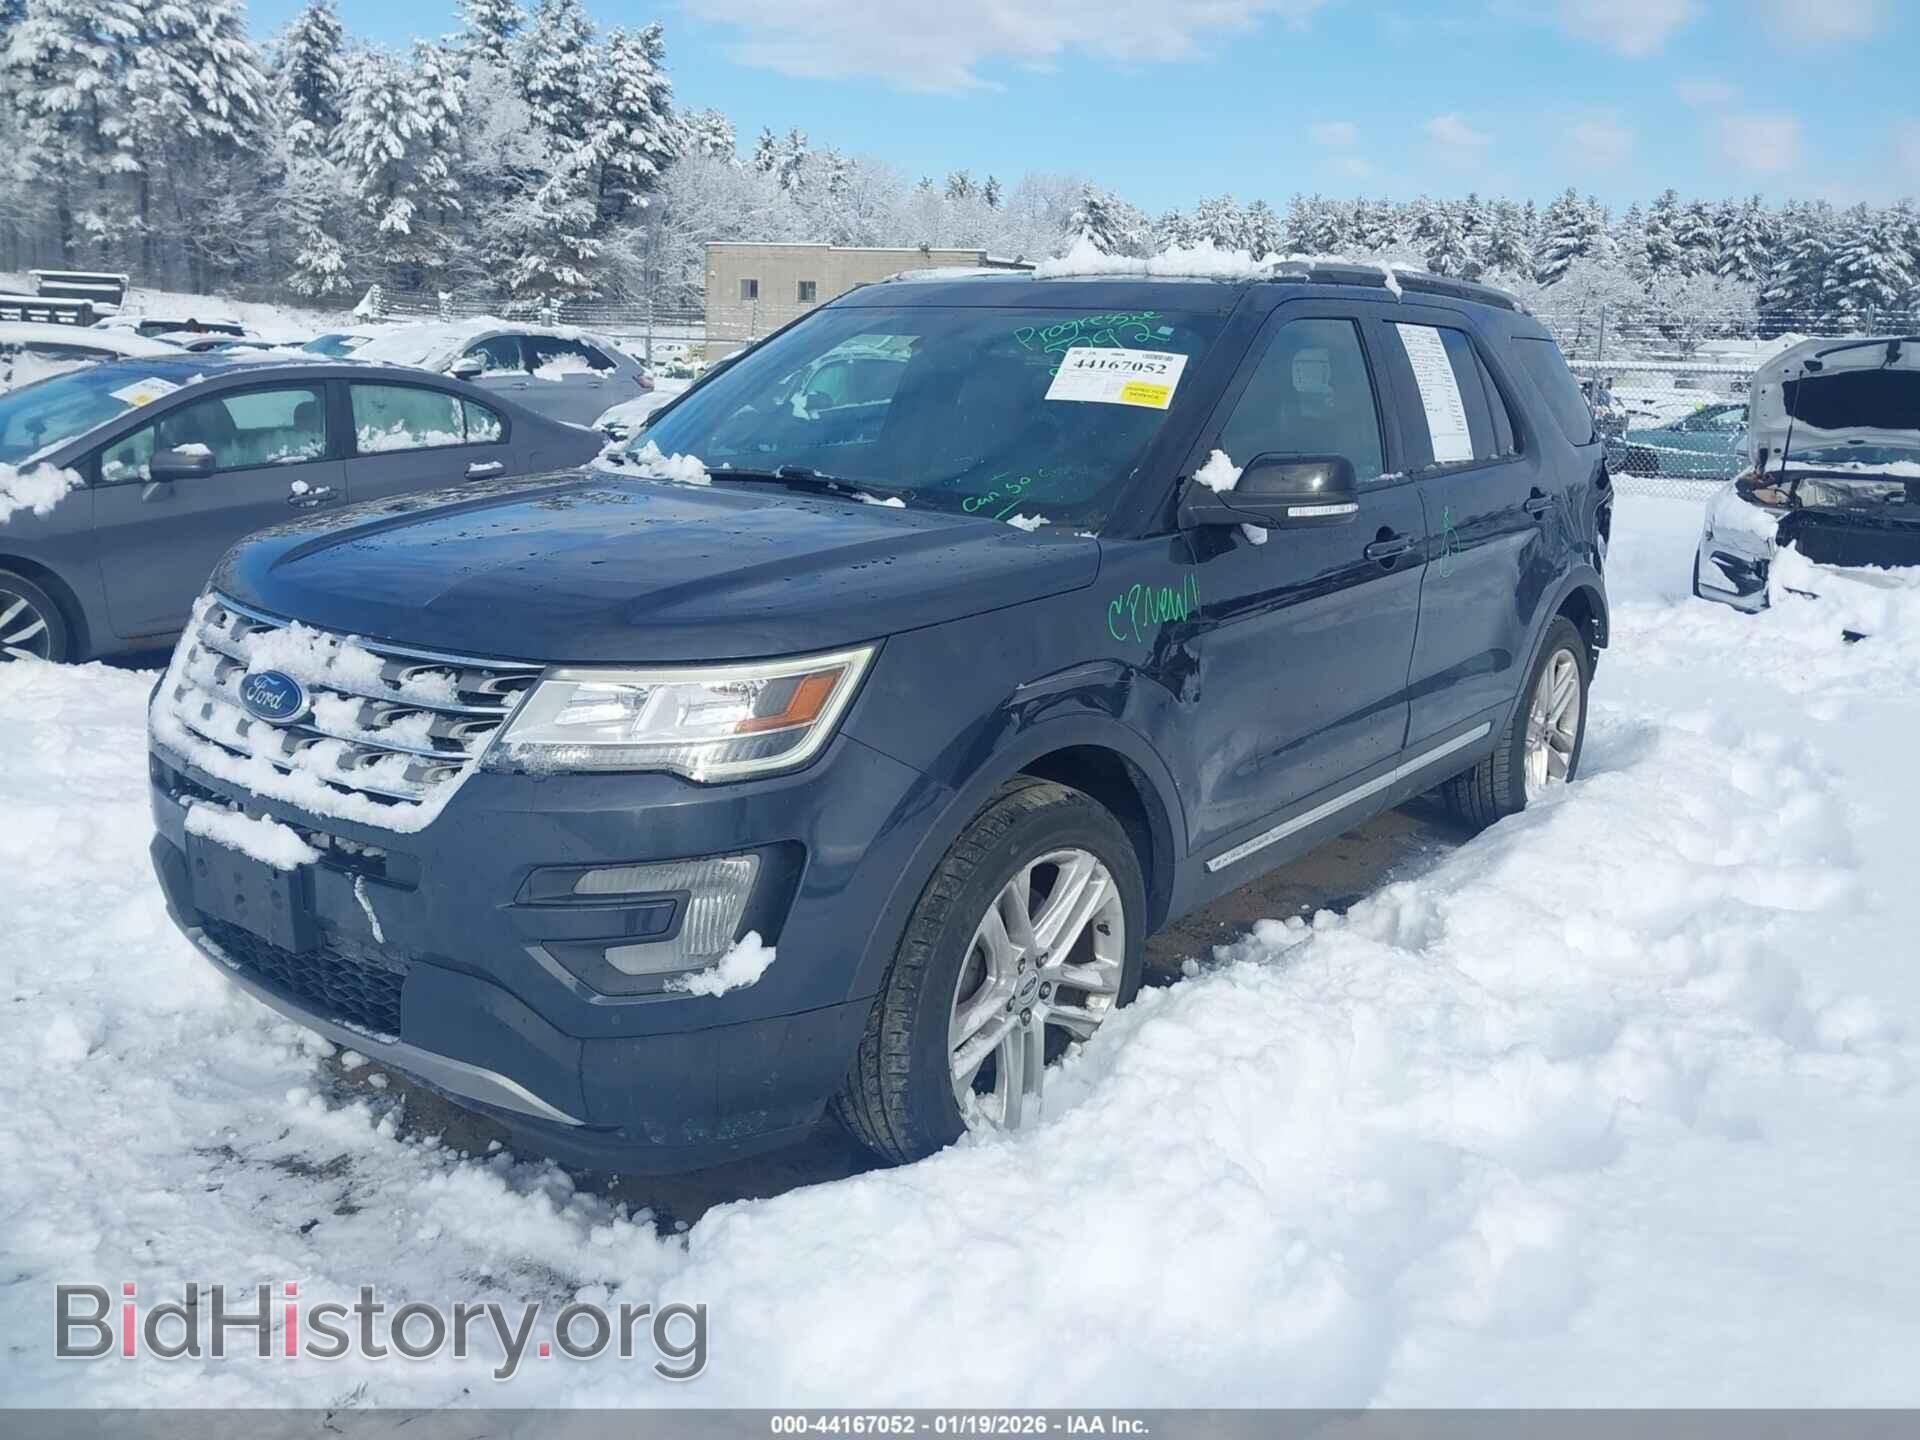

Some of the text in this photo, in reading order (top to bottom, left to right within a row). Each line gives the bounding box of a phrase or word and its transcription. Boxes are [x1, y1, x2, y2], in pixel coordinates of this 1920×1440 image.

[1013, 311, 1163, 353] Progressive
[1073, 359, 1167, 375] 44167052
[246, 674, 288, 710] Ford
